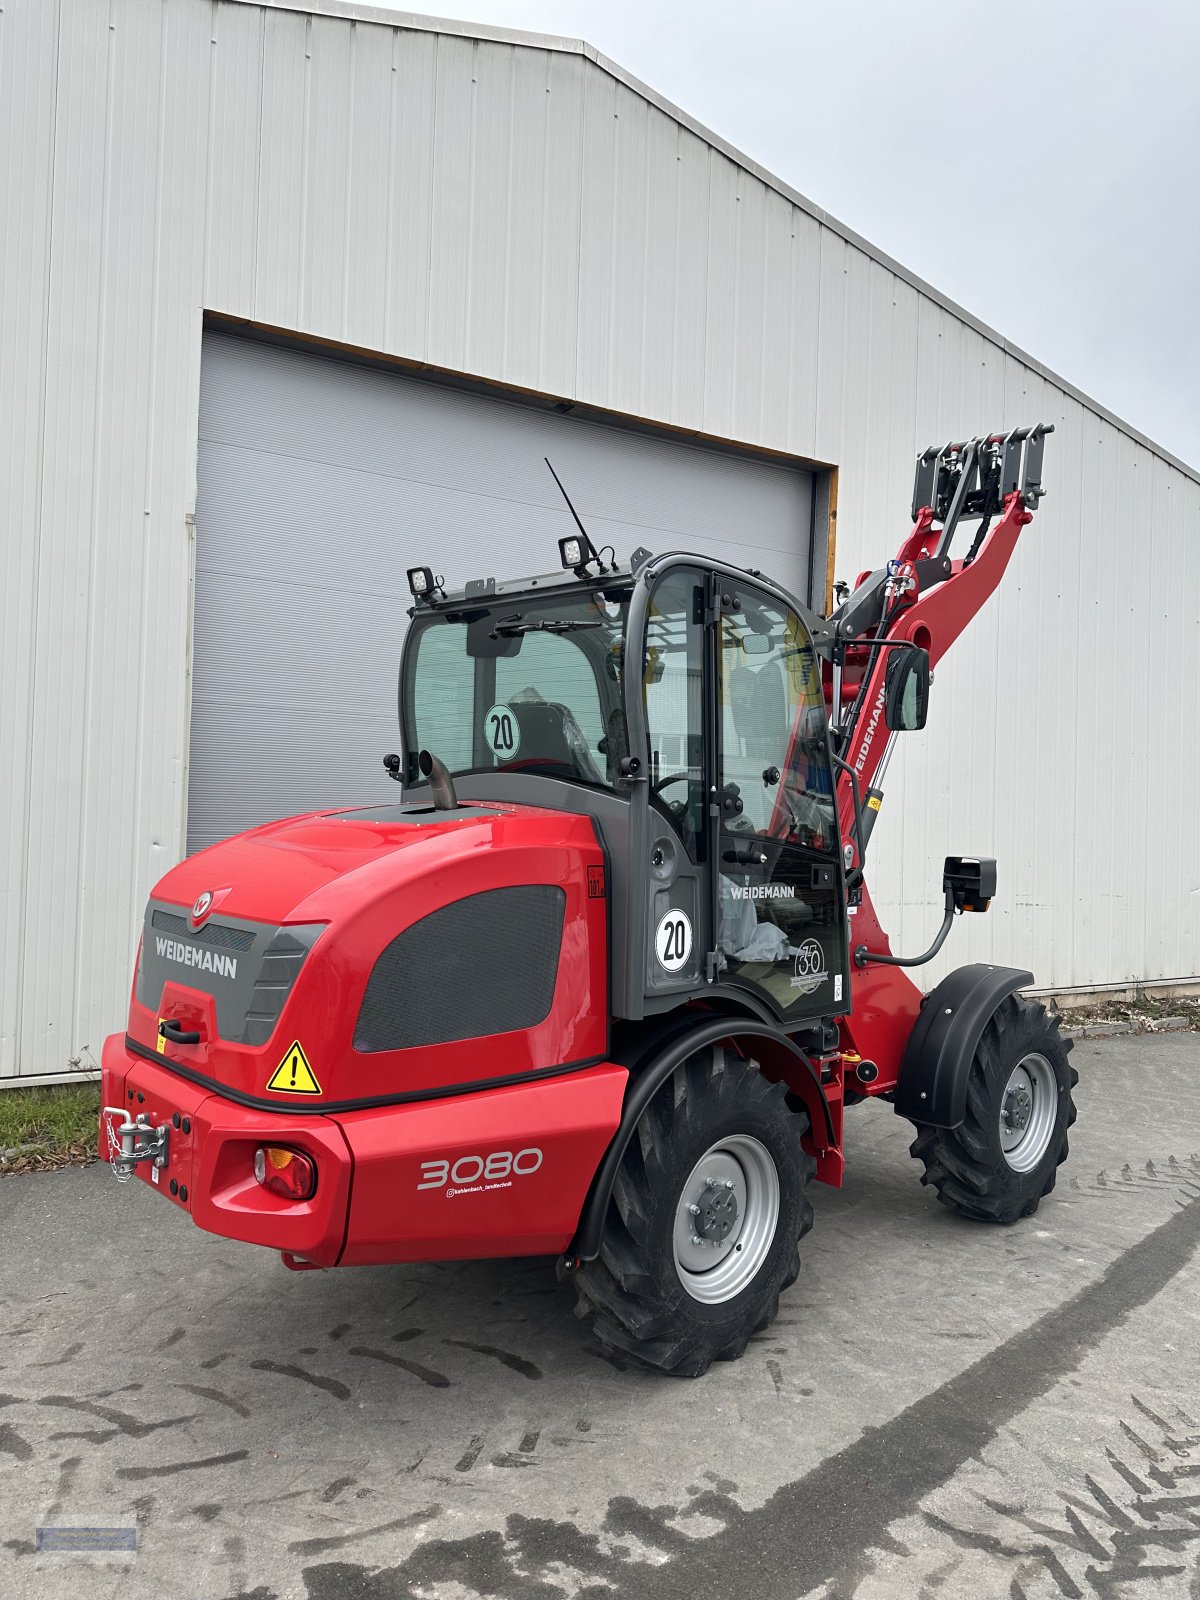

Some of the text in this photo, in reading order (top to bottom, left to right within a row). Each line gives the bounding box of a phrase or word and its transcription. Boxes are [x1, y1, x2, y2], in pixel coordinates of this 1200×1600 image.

[490, 714, 514, 750] 20
[730, 886, 795, 899] WEIDEMANN
[155, 936, 238, 979] WEIDEMANN
[663, 920, 685, 961] 20
[417, 1148, 543, 1190] 3080
